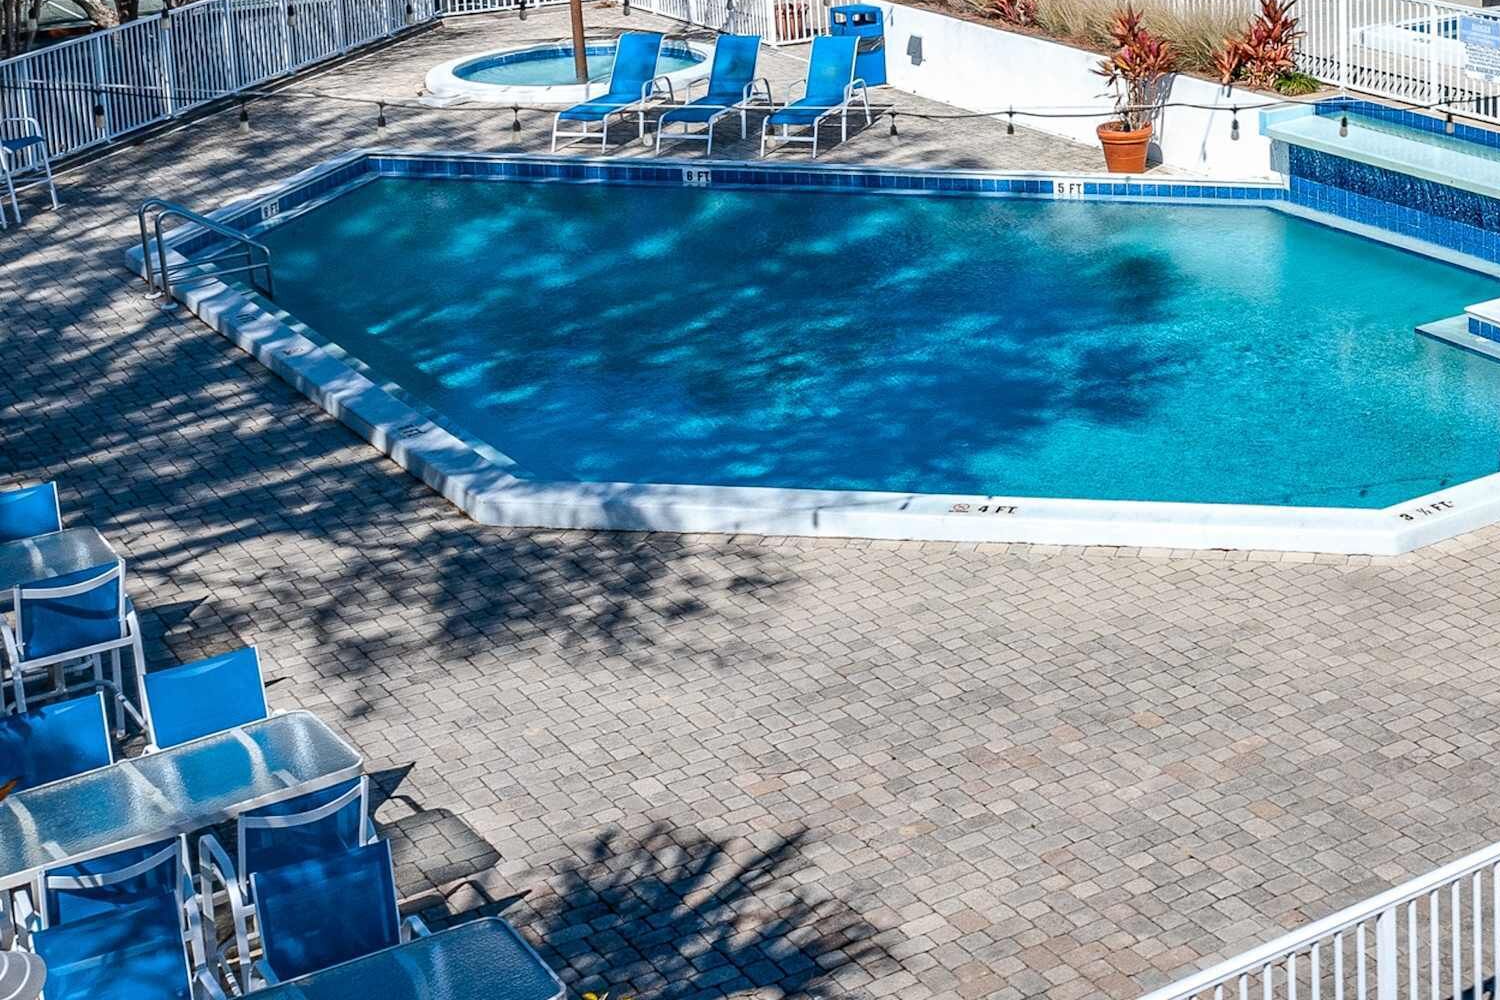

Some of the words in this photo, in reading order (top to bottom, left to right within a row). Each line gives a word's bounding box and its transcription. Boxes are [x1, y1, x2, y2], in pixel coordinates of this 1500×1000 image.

[697, 171, 710, 181] FT
[1057, 182, 1065, 194] 5
[1069, 183, 1082, 195] FT
[978, 505, 989, 513] 4
[994, 505, 1018, 514] FT
[1399, 512, 1414, 521] 3
[1430, 500, 1455, 512] FT
